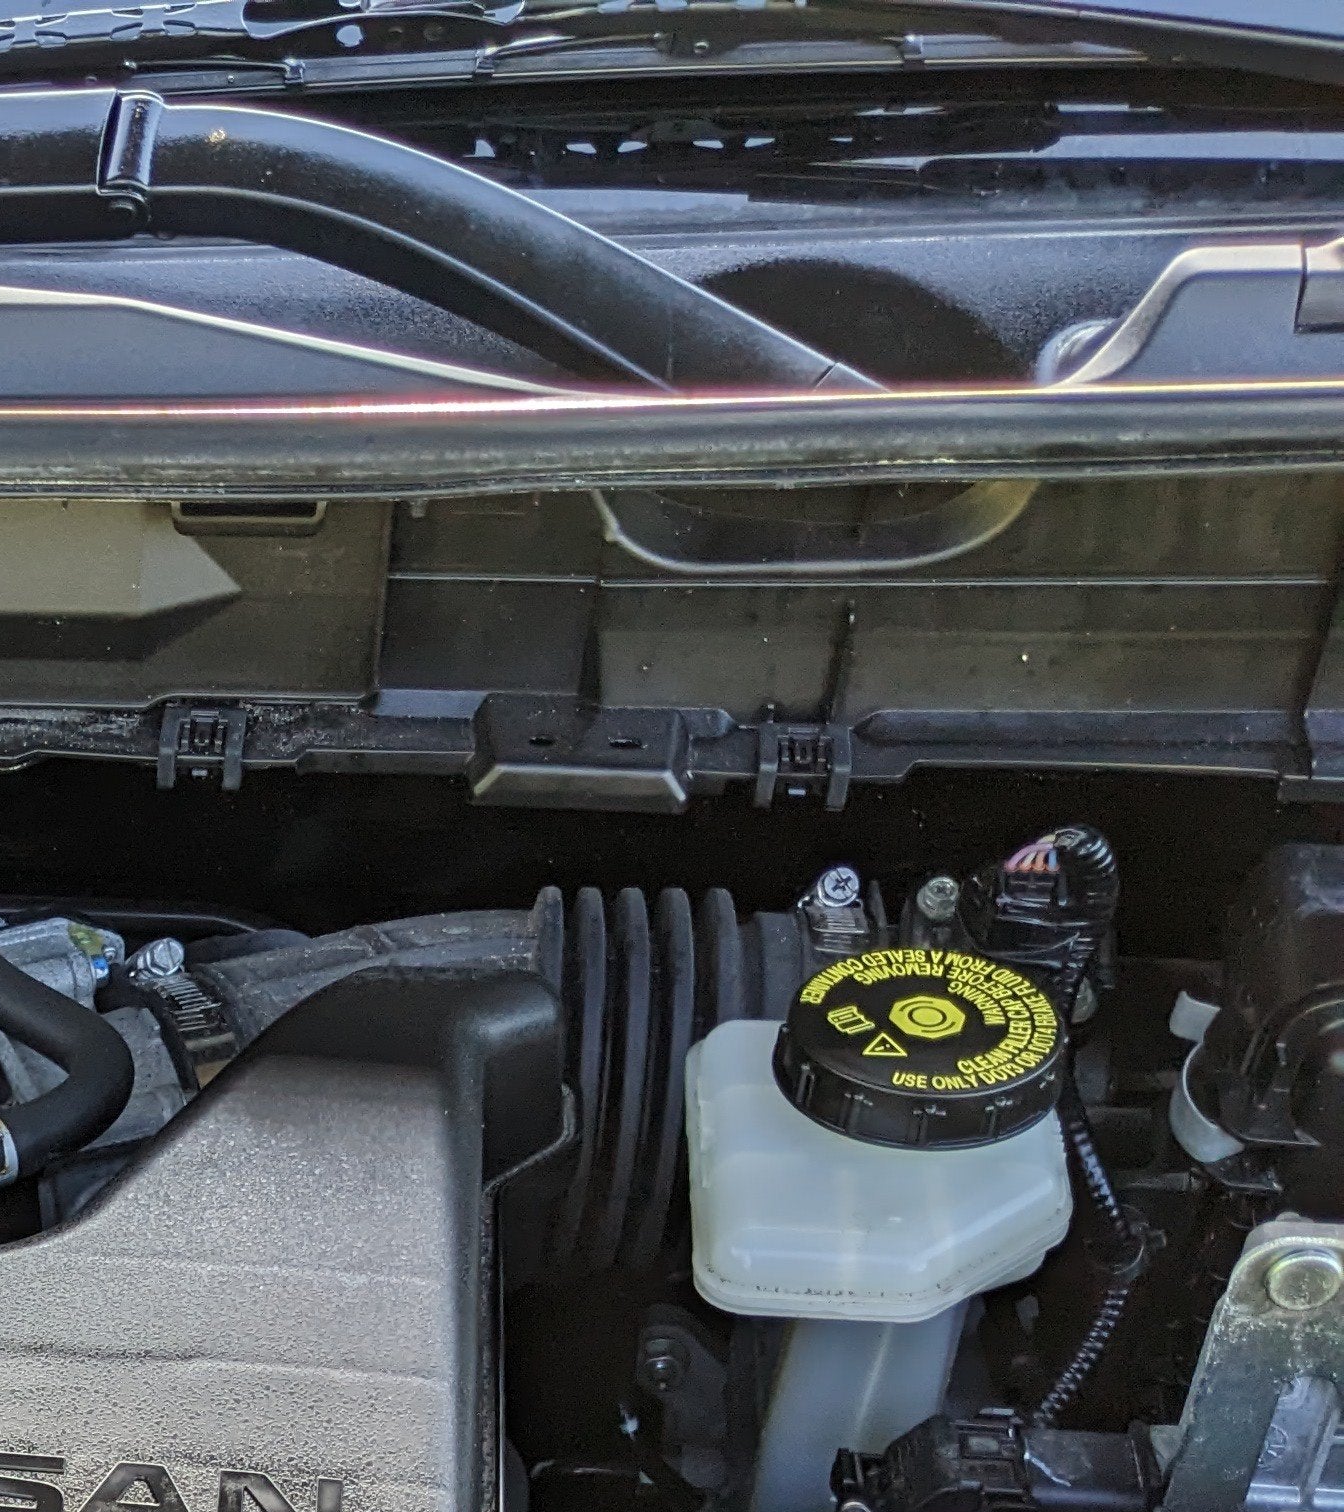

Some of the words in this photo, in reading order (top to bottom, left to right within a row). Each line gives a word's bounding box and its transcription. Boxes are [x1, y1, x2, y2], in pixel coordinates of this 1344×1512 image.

[861, 950, 926, 967] SEALED
[931, 950, 944, 964] A
[944, 952, 997, 976] FROM
[799, 958, 864, 1004] CONTAINER
[853, 962, 944, 986] REMOVING
[946, 966, 1013, 1000] BEFORE
[991, 968, 1037, 996] FLUID
[947, 980, 1006, 1025] WARNING
[999, 998, 1031, 1019] CAP
[1023, 993, 1058, 1026] BRAKE
[998, 1020, 1032, 1054] FILLER
[957, 1049, 1013, 1075] CLEAN
[1014, 1050, 1044, 1068] OR
[892, 1071, 928, 1090] USE
[931, 1073, 979, 1091] ONLY
